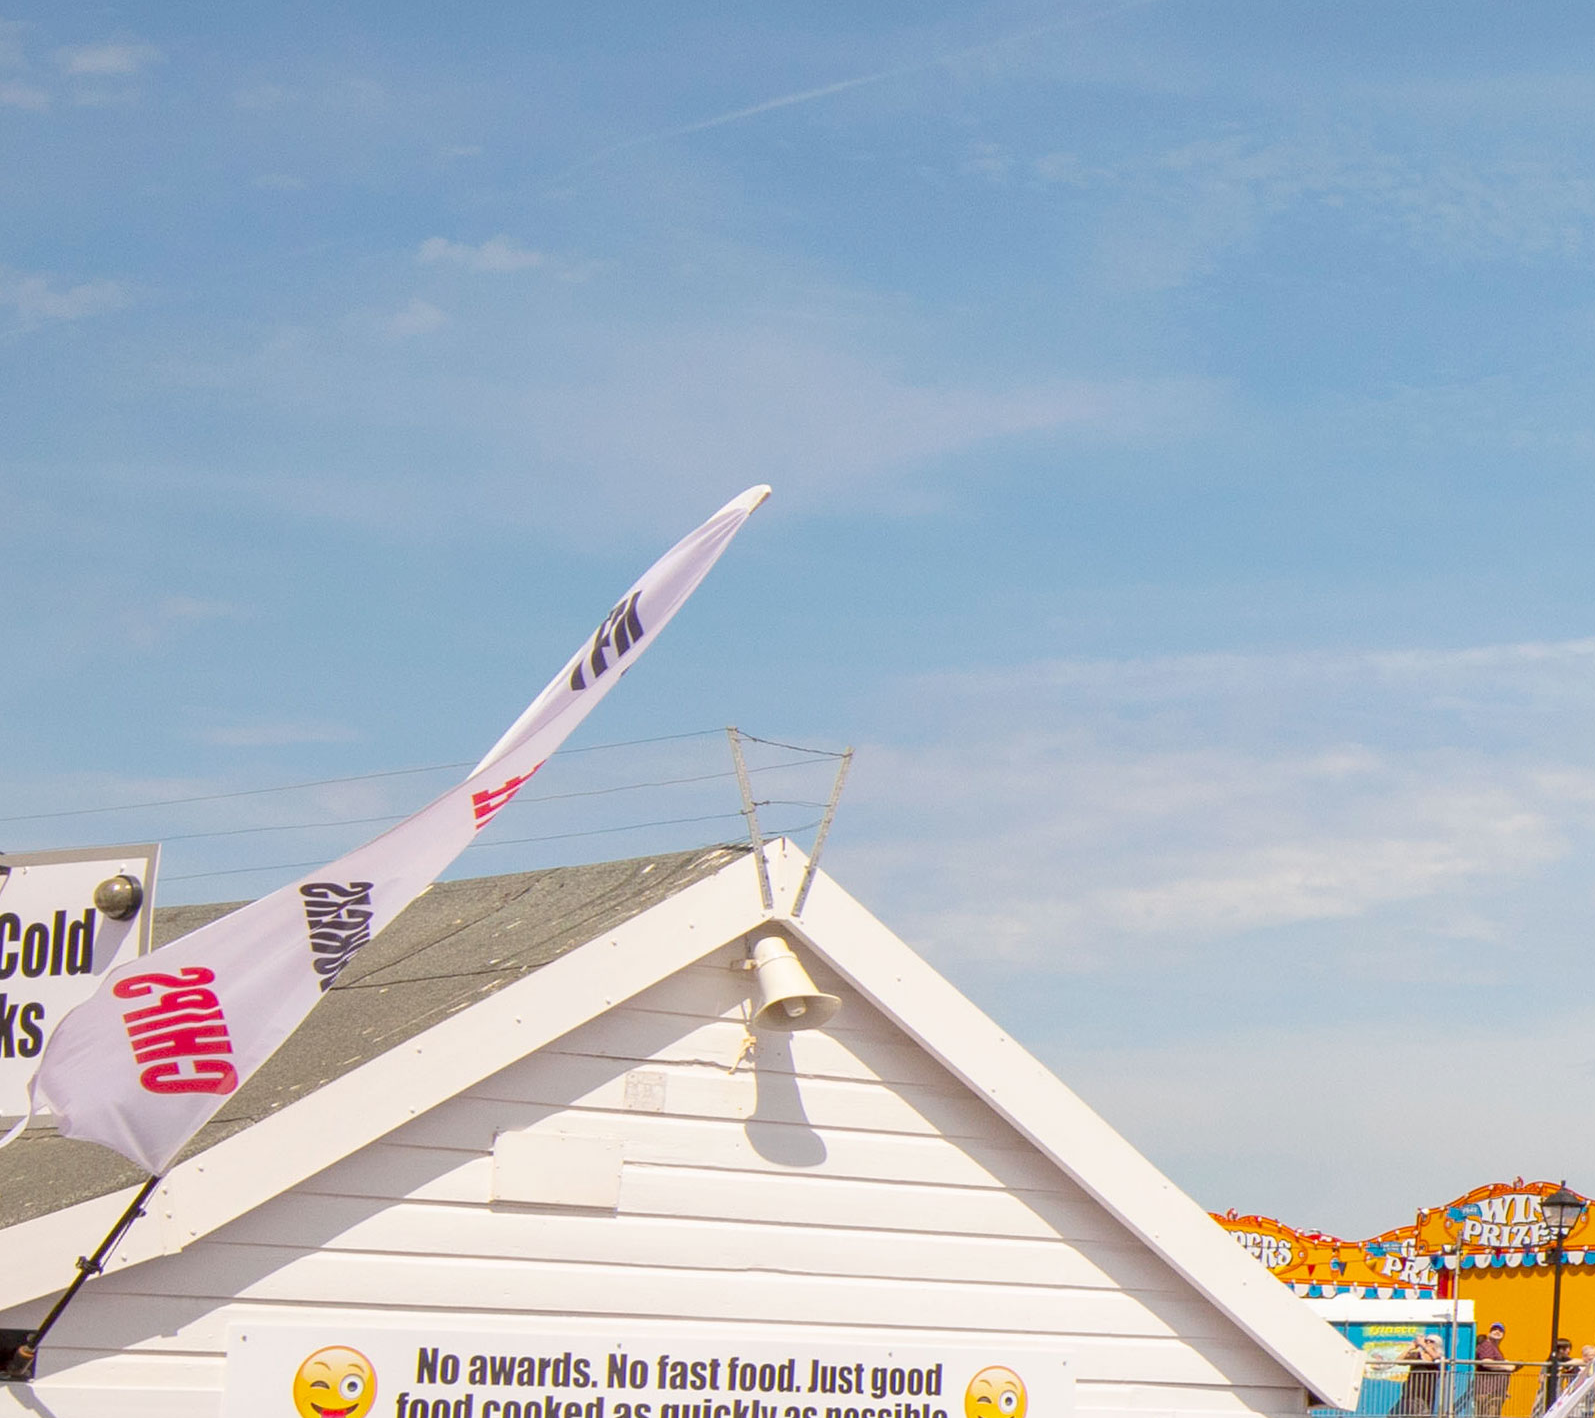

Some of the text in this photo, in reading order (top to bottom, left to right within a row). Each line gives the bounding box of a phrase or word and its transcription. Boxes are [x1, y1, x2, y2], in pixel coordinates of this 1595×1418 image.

[0, 908, 96, 980] Cold
[416, 1347, 943, 1399] No awards. No fast food. Just good
